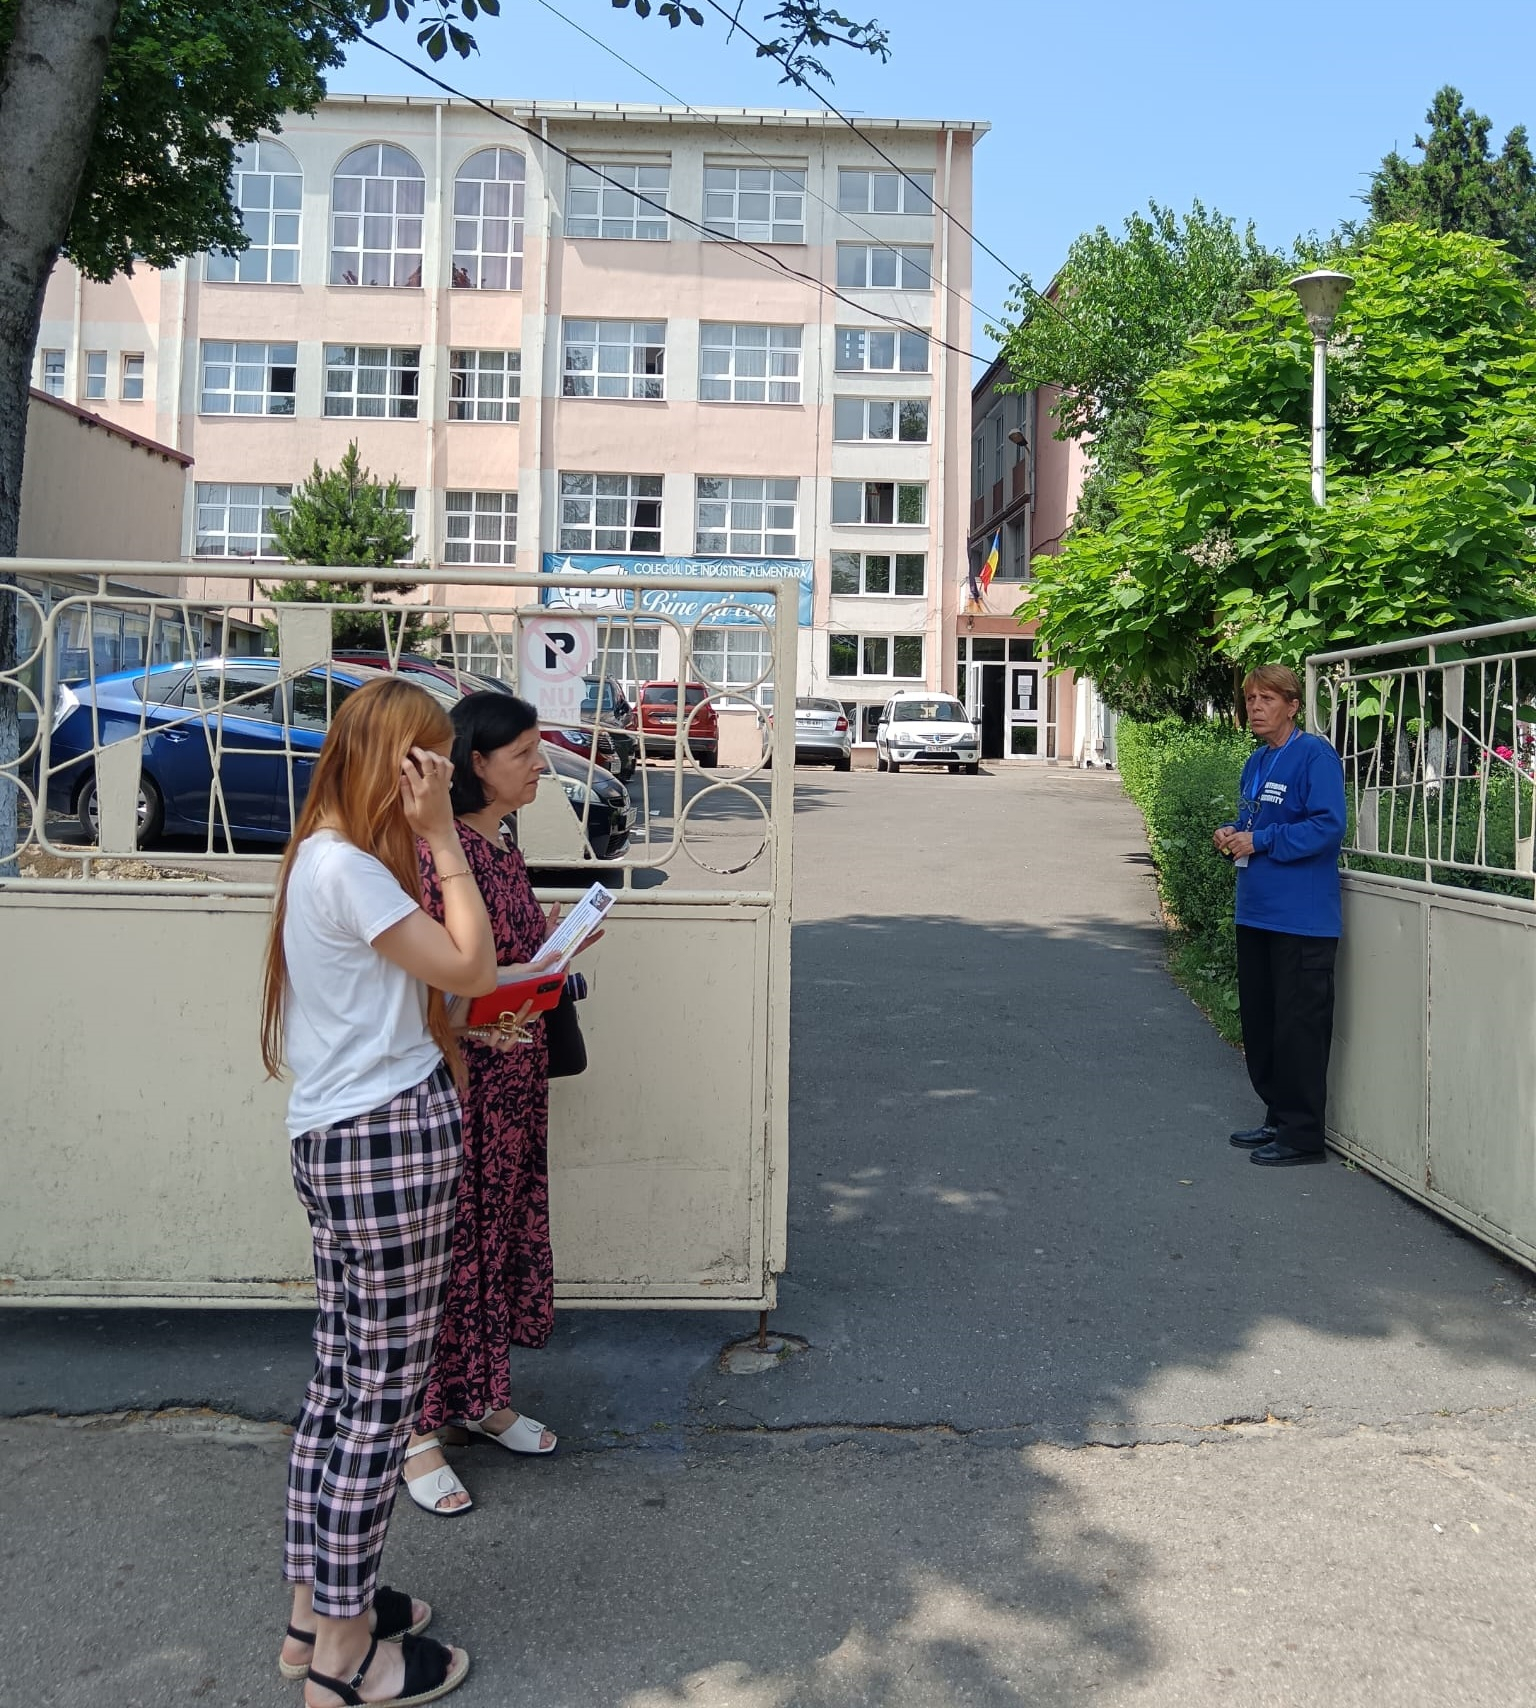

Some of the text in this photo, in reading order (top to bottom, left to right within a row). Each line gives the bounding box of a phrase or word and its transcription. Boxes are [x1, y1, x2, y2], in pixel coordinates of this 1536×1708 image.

[634, 562, 683, 575] COLEGIUL
[685, 563, 698, 576] DE
[700, 564, 747, 577] INDUSTRIE
[642, 589, 699, 616] Bine
[539, 687, 575, 706] NU
